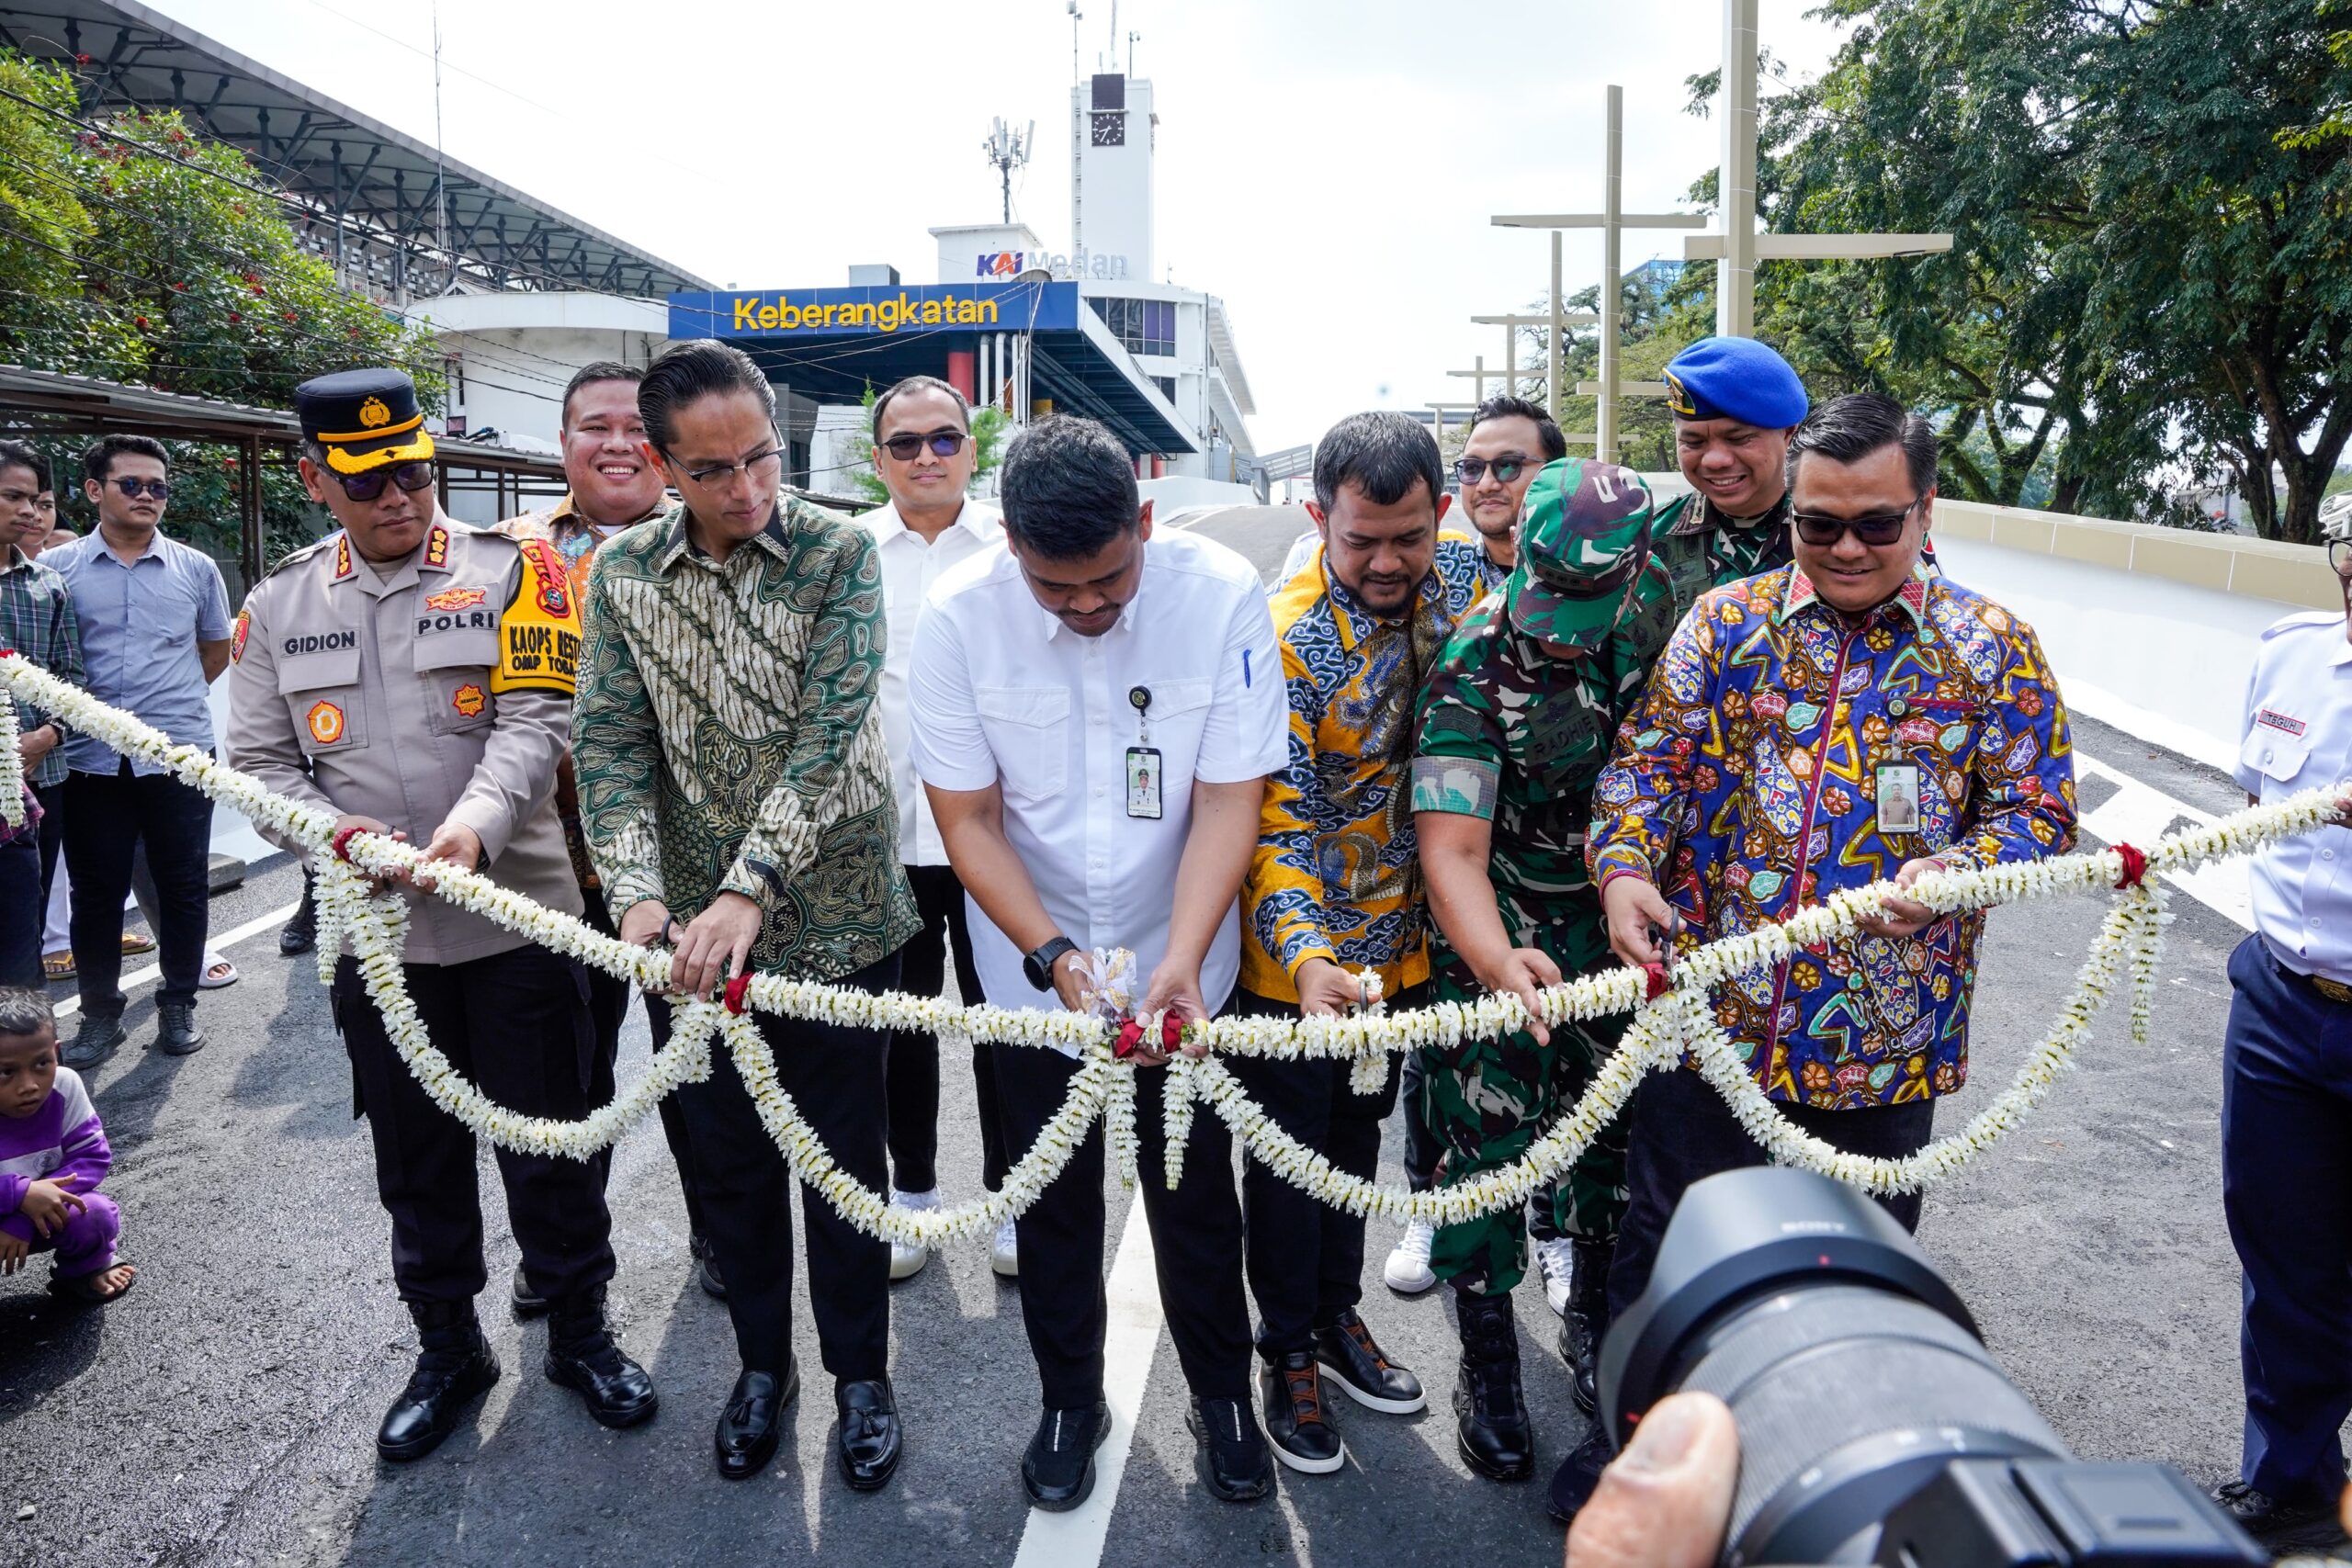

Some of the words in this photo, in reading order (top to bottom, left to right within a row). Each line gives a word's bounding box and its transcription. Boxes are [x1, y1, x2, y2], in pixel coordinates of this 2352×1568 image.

[977, 251, 1023, 276] KAI
[1028, 247, 1128, 276] Medan
[734, 292, 998, 332] Keberangkatan
[418, 612, 493, 635] POLRI
[284, 630, 355, 654] GIDION
[510, 626, 551, 655] KAOPS
[512, 655, 541, 671] OMP
[2267, 714, 2297, 731] TEGUH
